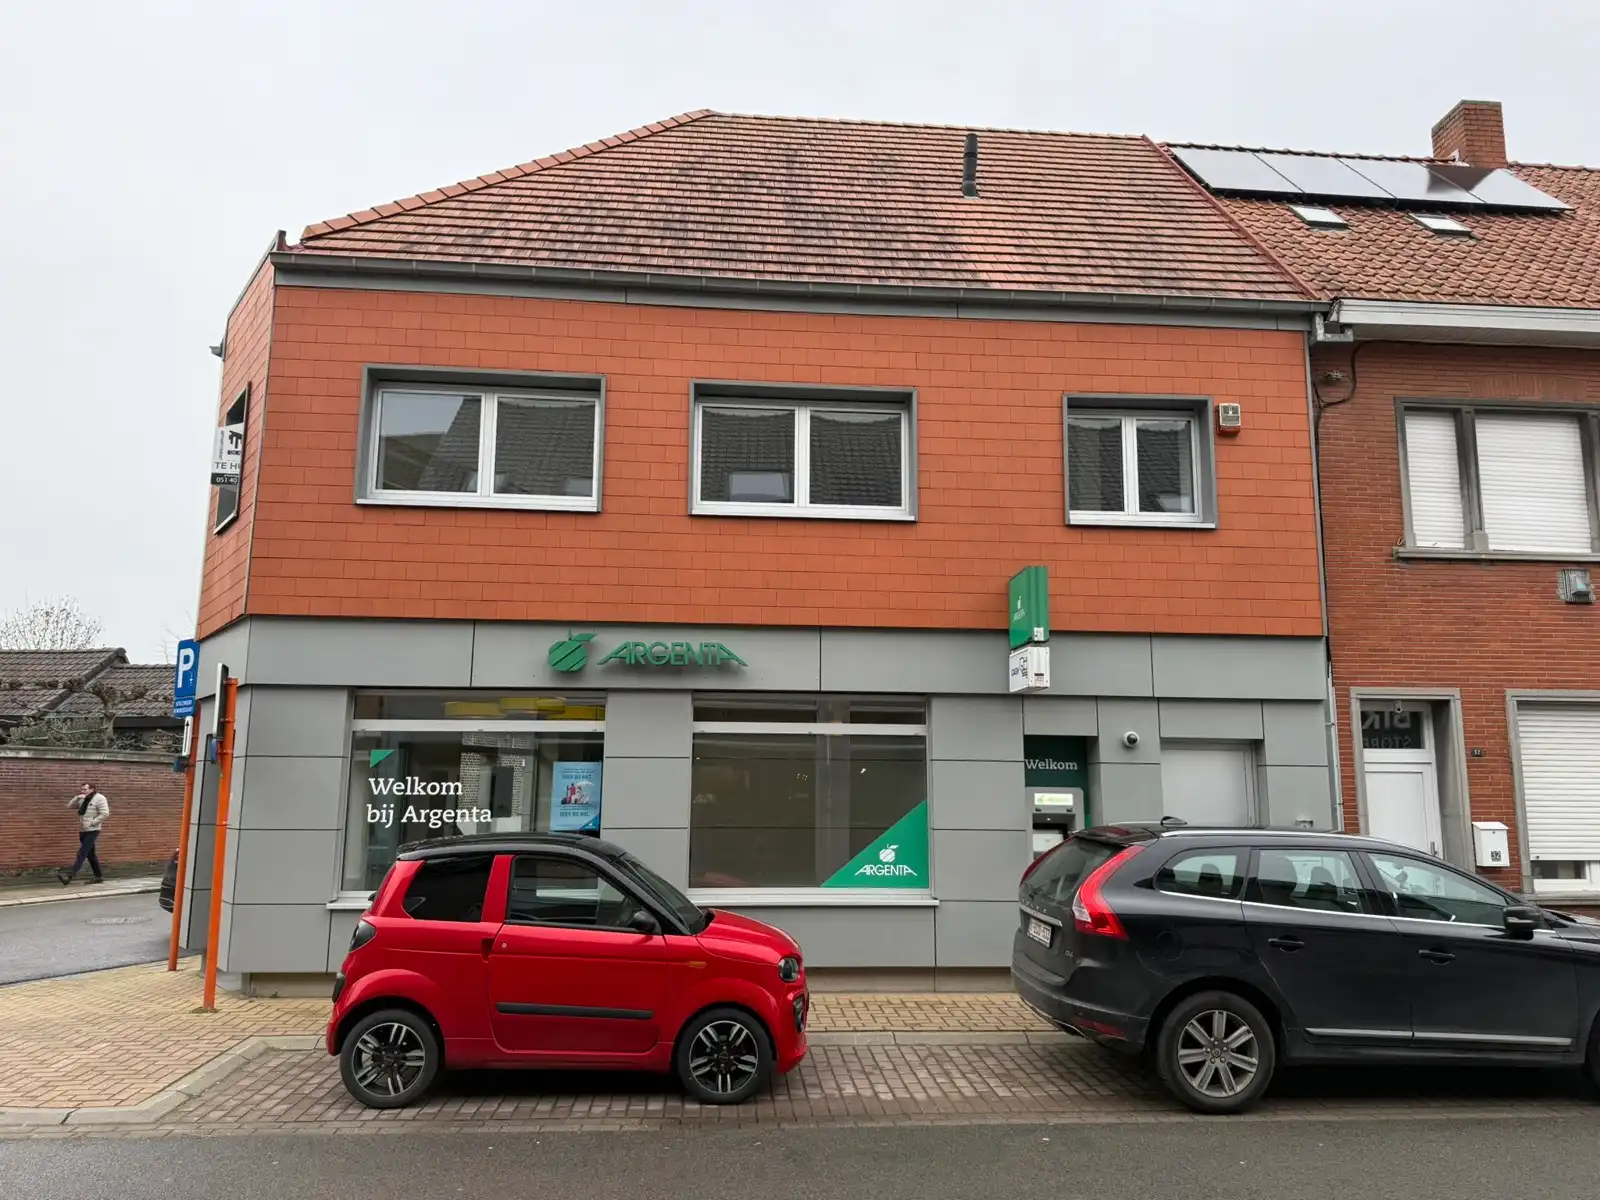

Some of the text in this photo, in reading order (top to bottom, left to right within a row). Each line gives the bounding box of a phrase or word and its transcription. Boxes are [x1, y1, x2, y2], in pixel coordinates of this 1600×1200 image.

[214, 462, 227, 470] TE
[597, 641, 748, 667] ARGENTA
[177, 648, 195, 688] P
[1025, 758, 1078, 771] Welkom
[368, 776, 463, 796] Welkom
[367, 804, 492, 828] bij Argenta
[1491, 851, 1501, 860] 32
[854, 864, 918, 876] ARGENTA
